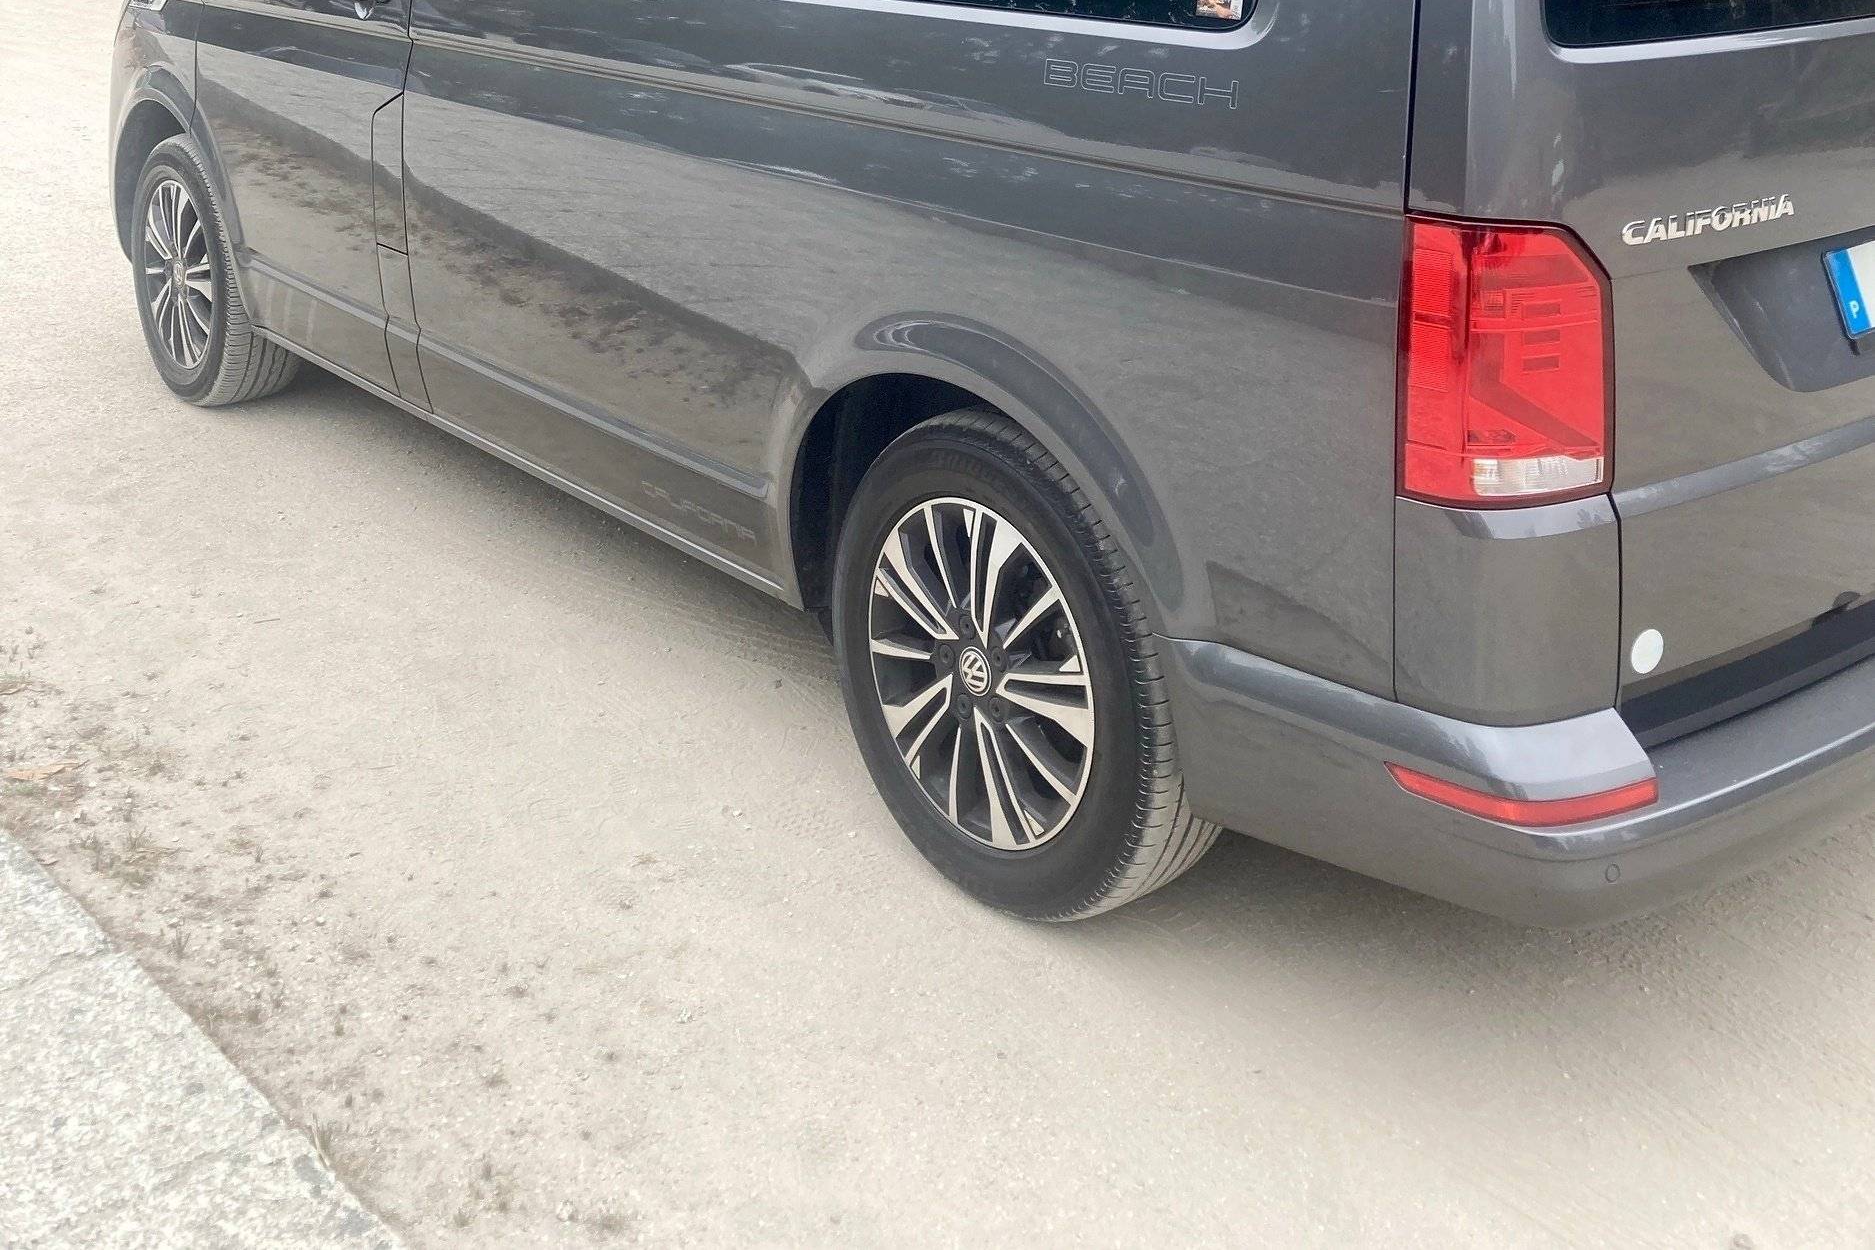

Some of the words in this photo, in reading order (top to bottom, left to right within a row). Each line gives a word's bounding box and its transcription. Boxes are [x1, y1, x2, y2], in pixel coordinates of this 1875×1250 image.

[1043, 58, 1239, 110] BEACH
[1621, 193, 1796, 246] CALIFORNIA
[1848, 300, 1861, 320] P
